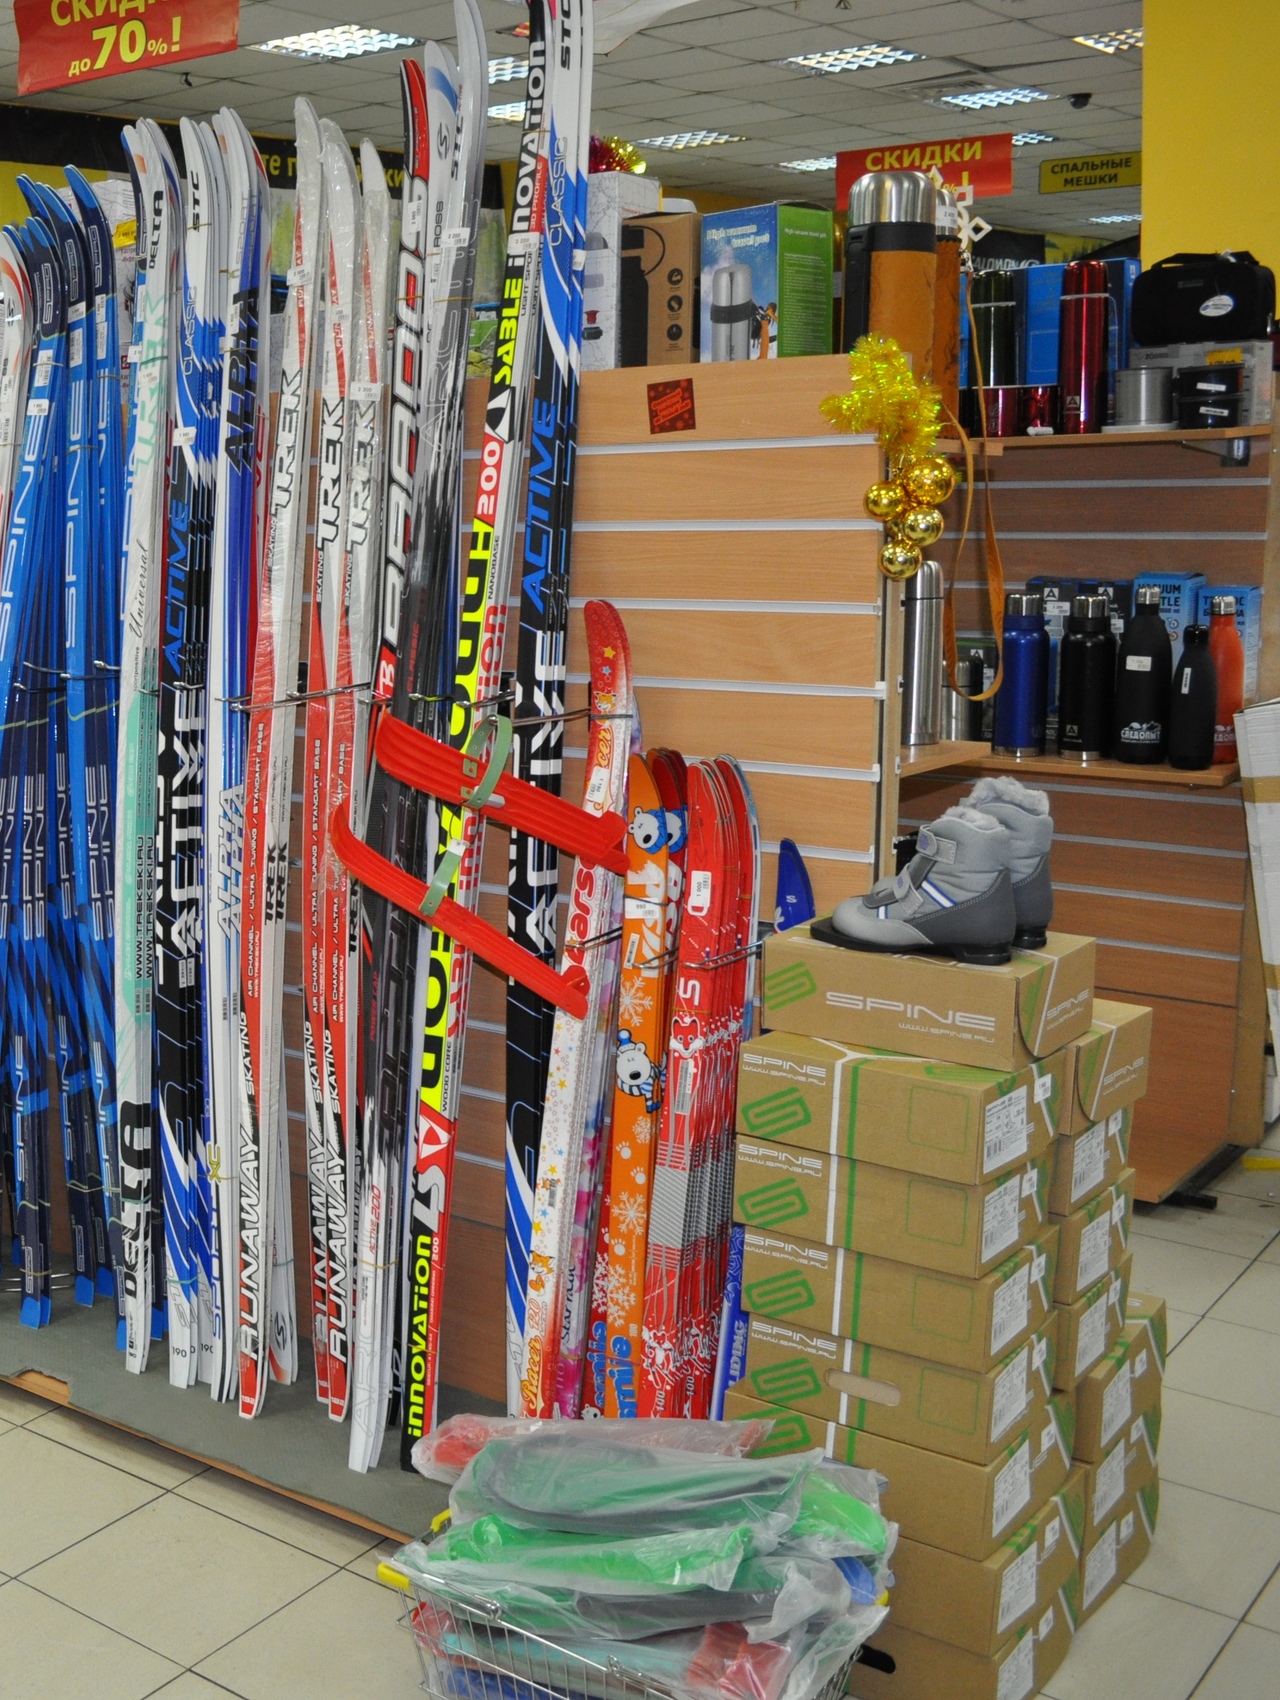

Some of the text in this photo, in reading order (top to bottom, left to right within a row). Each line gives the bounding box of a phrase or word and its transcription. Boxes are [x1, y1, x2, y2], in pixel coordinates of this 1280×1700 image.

[68, 58, 91, 77] до
[532, 162, 542, 211] PROFILE
[549, 137, 567, 247] CLASSIC
[865, 141, 983, 171] СКИДКИ
[1050, 156, 1132, 175] СПАЛЬНЫЕ
[1063, 173, 1119, 188] МЕШКИ
[147, 190, 164, 269] DELTA
[187, 169, 202, 228] STC
[182, 285, 197, 376] CLASSIC
[494, 277, 522, 386] SABLE
[224, 289, 245, 476] ALPHA
[270, 366, 301, 516] TREK
[317, 397, 345, 549] TREK
[347, 397, 375, 551] TREK
[476, 440, 500, 516] 200
[66, 379, 84, 648] SPINE
[522, 397, 555, 615] ACTIVE
[127, 539, 150, 639] Universal
[163, 500, 188, 676] ACTIVE
[487, 535, 500, 600] NANOBASE
[256, 722, 264, 753] BASE
[1120, 729, 1162, 741] СЛЕДОПЫТ
[170, 688, 202, 957] ACTIVE
[252, 757, 263, 815] STANDART
[312, 772, 321, 832] STANDART
[56, 753, 70, 921] SPINE
[86, 766, 101, 927] SPINE
[217, 789, 232, 939] ALPHA
[135, 835, 144, 980] WWW.TREKSKI.RU
[264, 841, 276, 925] TREK
[825, 991, 996, 1031] SPINE
[1046, 989, 1090, 1020] SPINE
[239, 1011, 255, 1096] SKATING
[304, 1021, 323, 1105] SKATING
[323, 1029, 342, 1115] SKATING
[441, 1041, 452, 1113] WOOD CORE
[742, 1053, 827, 1077] SPINE
[1102, 1056, 1145, 1086] SPINE
[93, 1041, 111, 1197] SPINE
[738, 1144, 823, 1169] SPINE
[120, 1100, 151, 1297] DELTA
[371, 1185, 380, 1220] 200
[239, 1125, 260, 1362] RUNAWAY
[328, 1137, 348, 1364] RUNAWAY
[431, 1237, 439, 1262] 200
[744, 1234, 829, 1261] SPINE
[527, 1300, 540, 1327] 120
[538, 1301, 548, 1336] Larsen
[559, 1265, 575, 1343] Star rain
[629, 1323, 638, 1338] 100
[751, 1321, 838, 1351] SPINE
[521, 1336, 542, 1408] Racer
[656, 1391, 665, 1412] 100
[686, 1376, 694, 1397] 100
